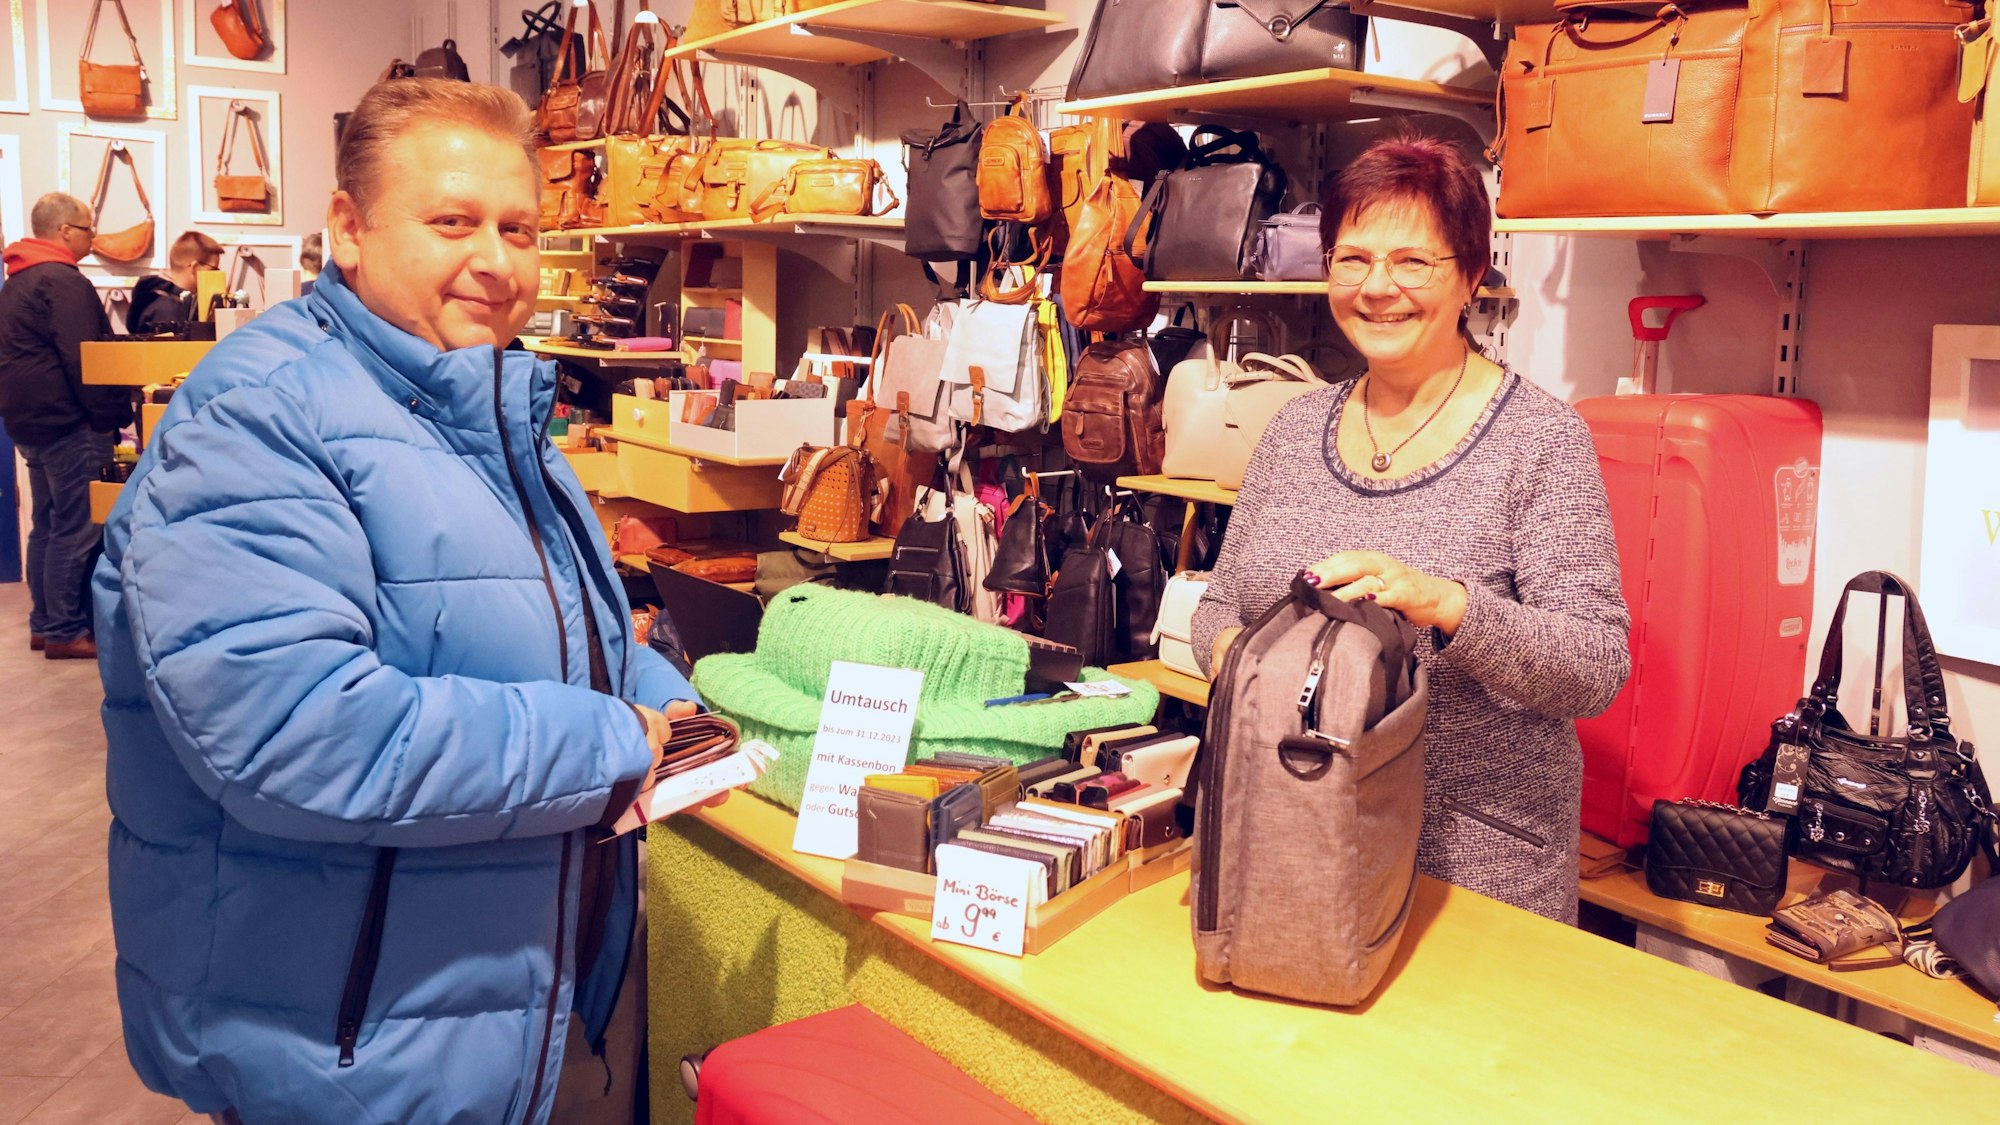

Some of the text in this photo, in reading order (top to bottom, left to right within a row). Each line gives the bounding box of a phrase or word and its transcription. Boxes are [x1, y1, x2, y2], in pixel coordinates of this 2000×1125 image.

[830, 689, 908, 714] Umtausch
[822, 724, 902, 744] bis zum 31.12.2023
[816, 752, 897, 774] mit Kassenbon
[809, 783, 835, 794] gegen
[805, 803, 825, 813] oder
[943, 878, 1019, 908] Mini Börse
[935, 915, 950, 930] ab
[992, 931, 1001, 942] €
